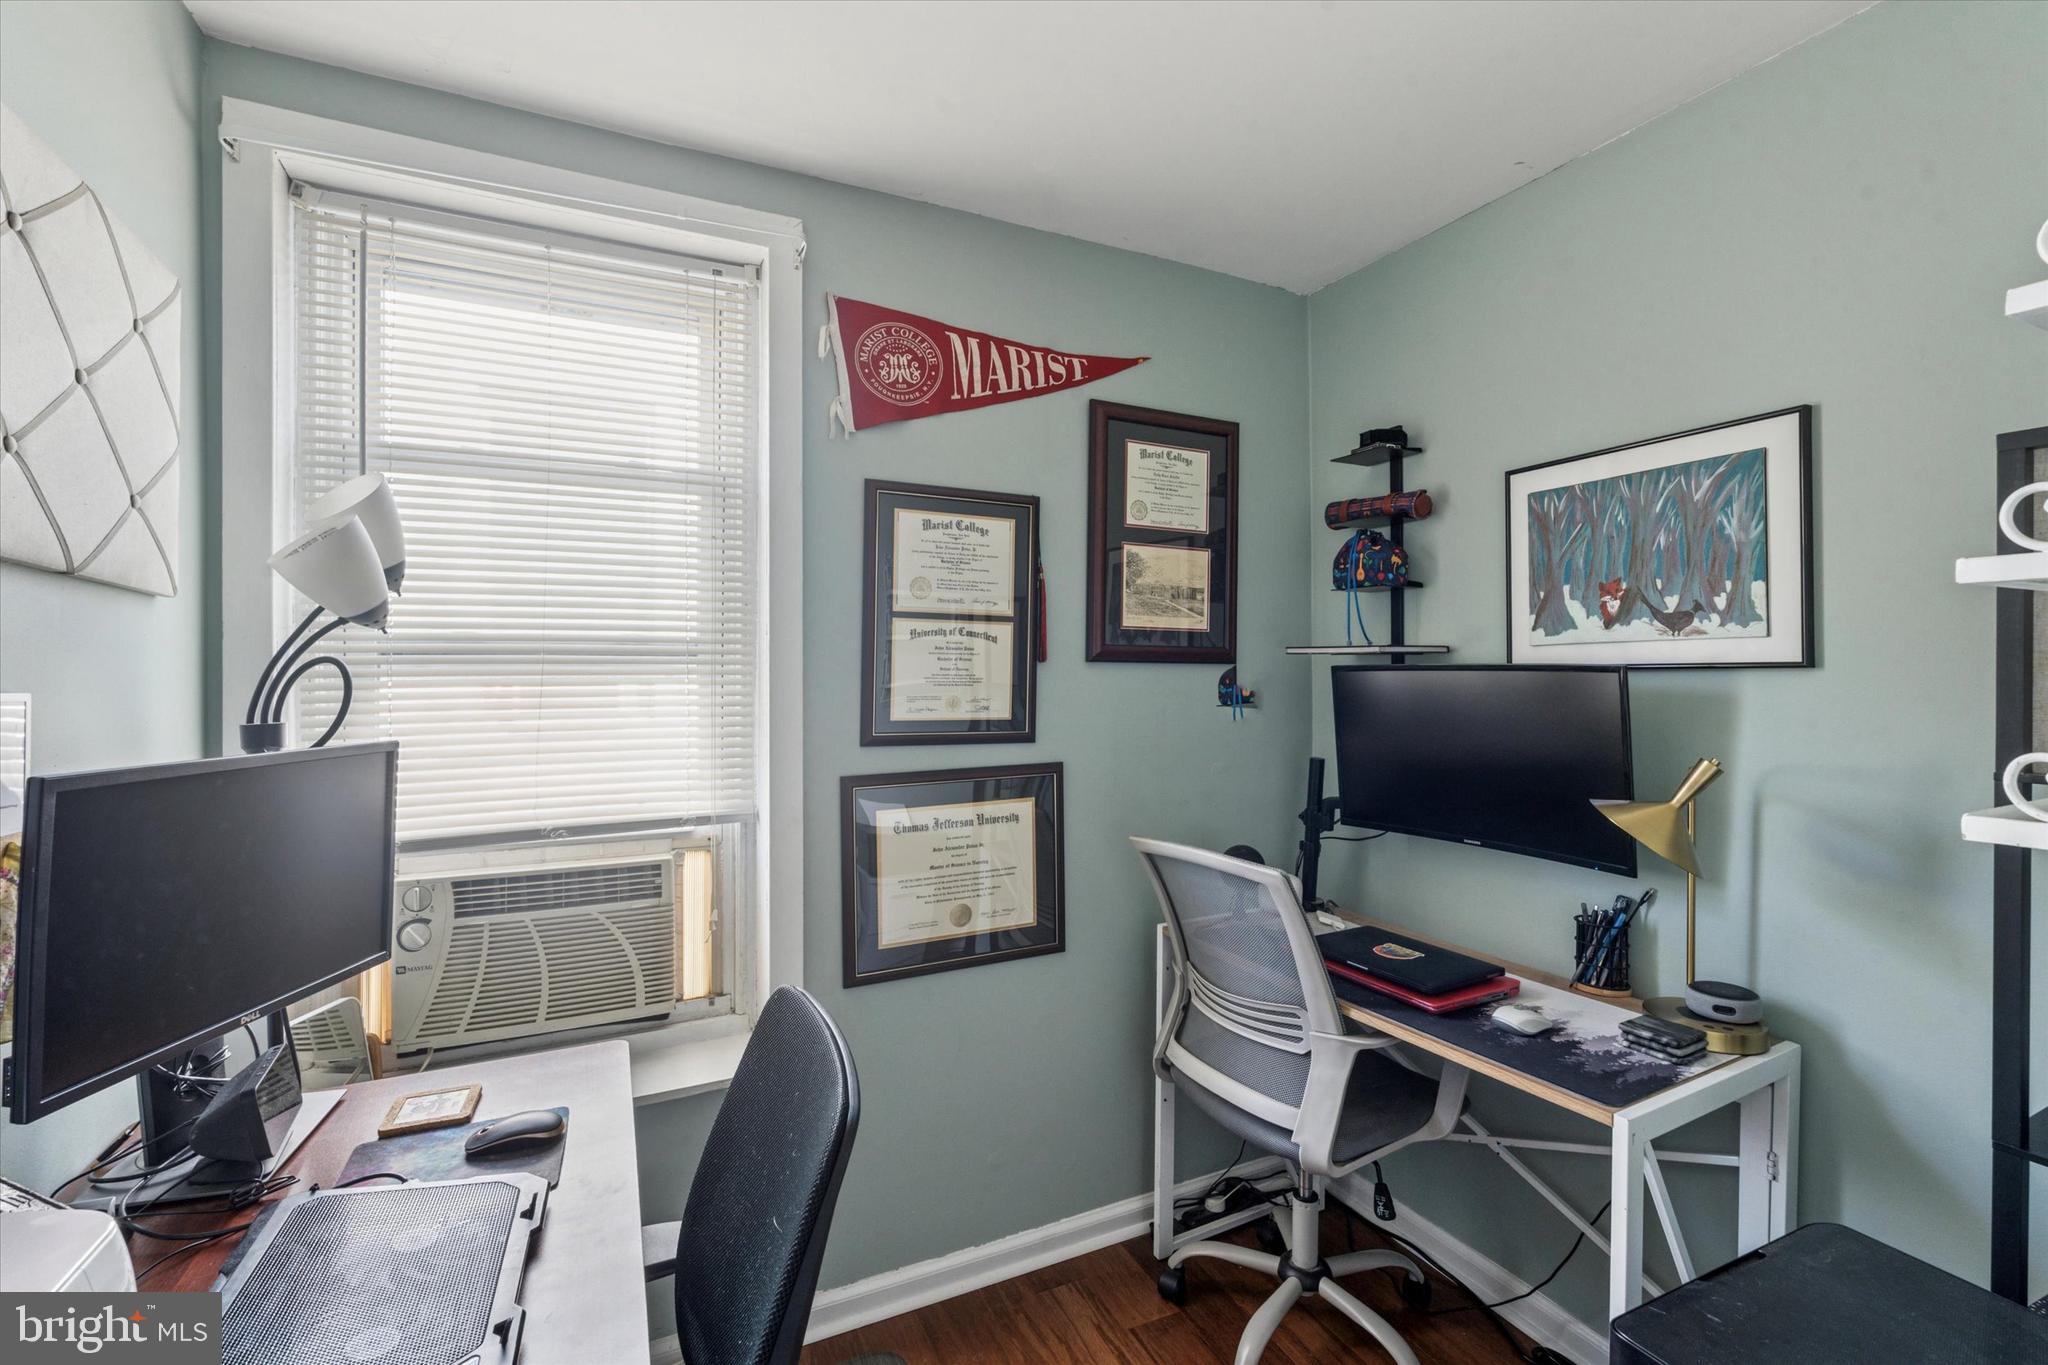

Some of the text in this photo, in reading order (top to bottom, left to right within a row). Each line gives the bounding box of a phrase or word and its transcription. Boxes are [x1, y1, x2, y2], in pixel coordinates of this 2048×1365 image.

[860, 327, 938, 366] MARIST COLLEGE
[944, 330, 1089, 400] MARIST
[1139, 448, 1164, 460] Marist
[1166, 450, 1193, 467] College
[921, 518, 990, 537] Marist College
[909, 627, 998, 644] University of Connecticut
[893, 812, 1020, 835] Thomas Jefferson University
